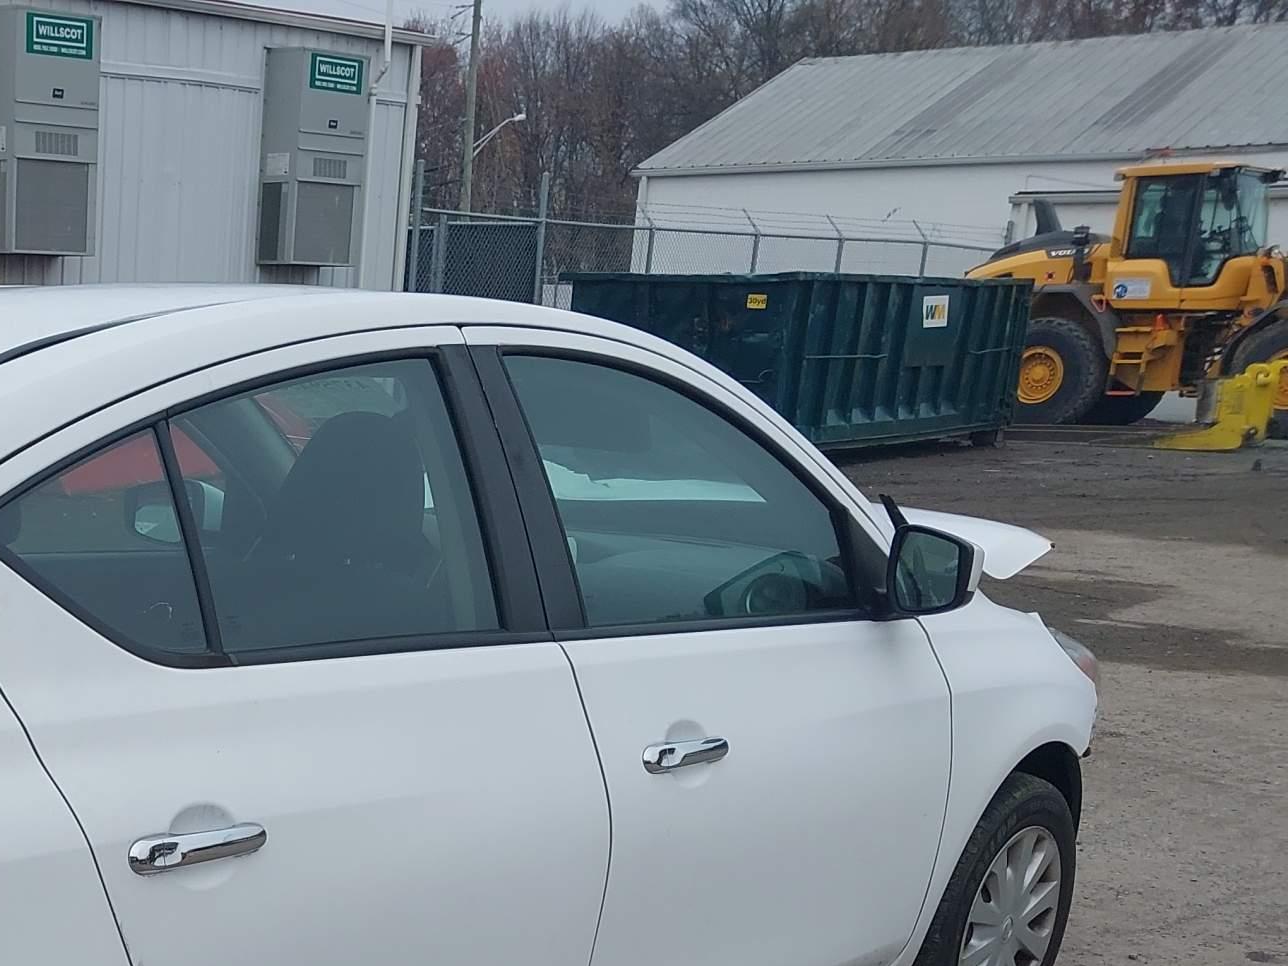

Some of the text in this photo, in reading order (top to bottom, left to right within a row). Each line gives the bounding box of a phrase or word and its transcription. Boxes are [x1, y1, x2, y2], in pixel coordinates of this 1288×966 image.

[38, 23, 83, 40] WILLSCOT
[319, 62, 355, 78] WILLSCOT
[925, 304, 946, 320] WM
